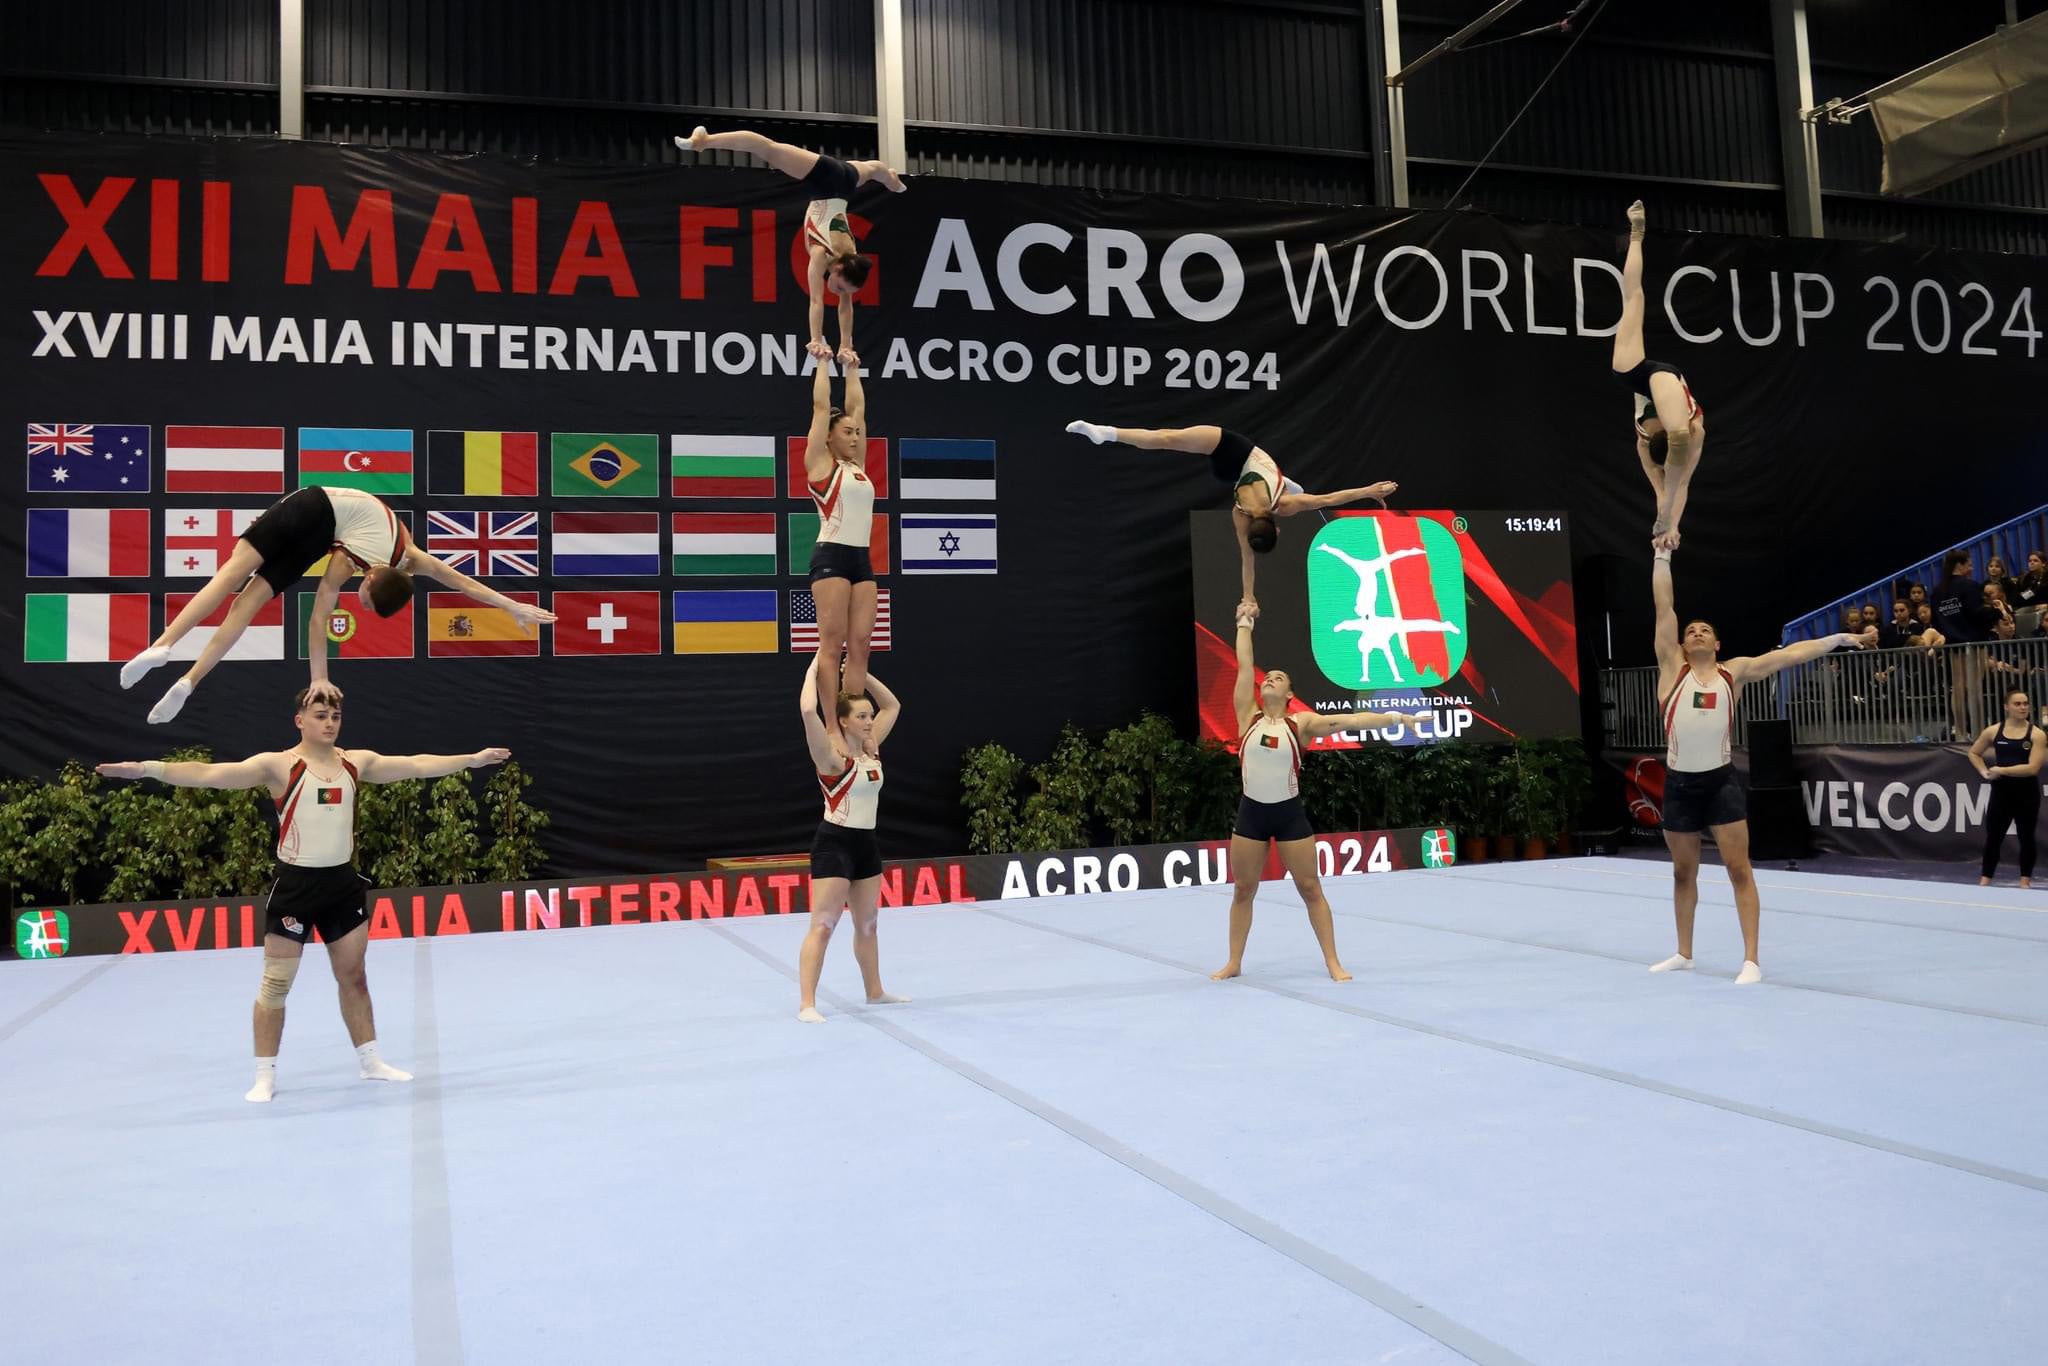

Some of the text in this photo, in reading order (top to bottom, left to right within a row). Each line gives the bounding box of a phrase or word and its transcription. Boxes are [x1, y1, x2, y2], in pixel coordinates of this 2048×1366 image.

[35, 173, 2044, 358] XII MAIA FIG ACRO WORLD CUP 2024
[32, 310, 188, 360] XVIII
[210, 316, 374, 366] MAIA
[881, 337, 1033, 382] ACRO
[1047, 343, 1152, 387] CUP
[1164, 349, 1281, 391] 2024
[1505, 518, 1561, 532] 15:19:41
[1316, 695, 1473, 711] MAIA INTERNATIONAL
[1414, 708, 1473, 739] CUP
[312, 893, 471, 945] AIA
[501, 864, 976, 932] INTERNATNAL
[1001, 852, 1140, 899] ACRO
[1163, 846, 1229, 889] CU
[1283, 836, 1392, 880] 024
